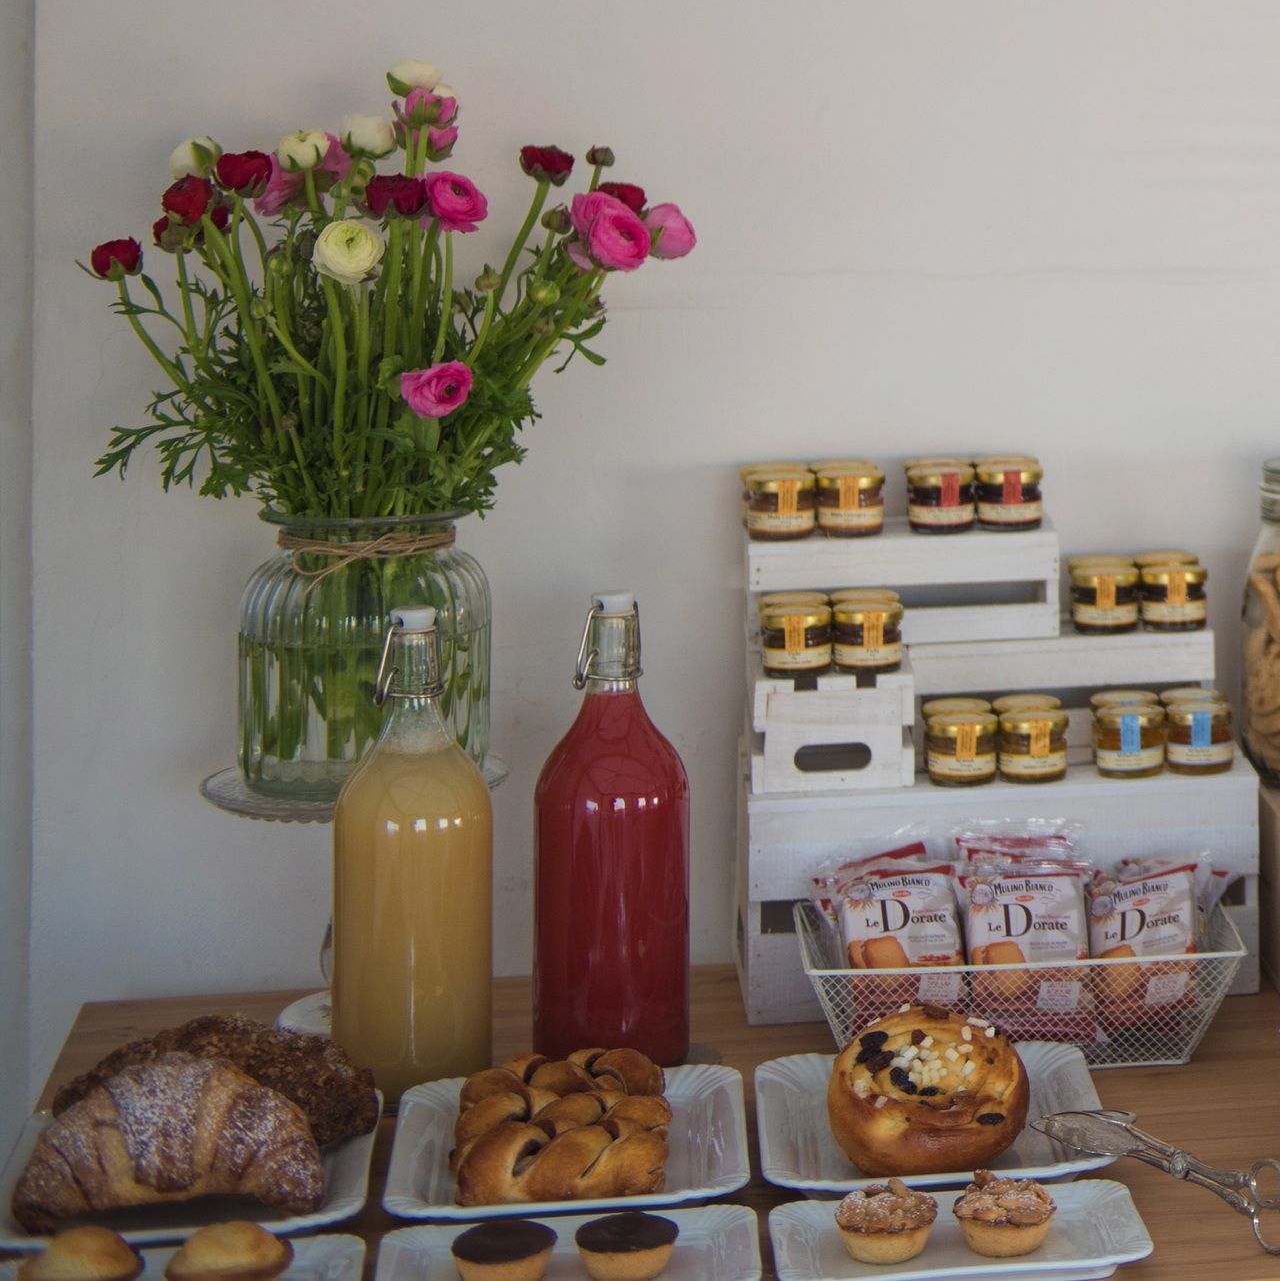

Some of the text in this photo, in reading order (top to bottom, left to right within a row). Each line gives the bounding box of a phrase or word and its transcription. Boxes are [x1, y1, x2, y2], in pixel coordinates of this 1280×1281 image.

[865, 899, 947, 933] Le Dorate
[988, 903, 1068, 938] Le Dorate
[1104, 931, 1118, 940] Le
[1118, 908, 1180, 943] Dorate
